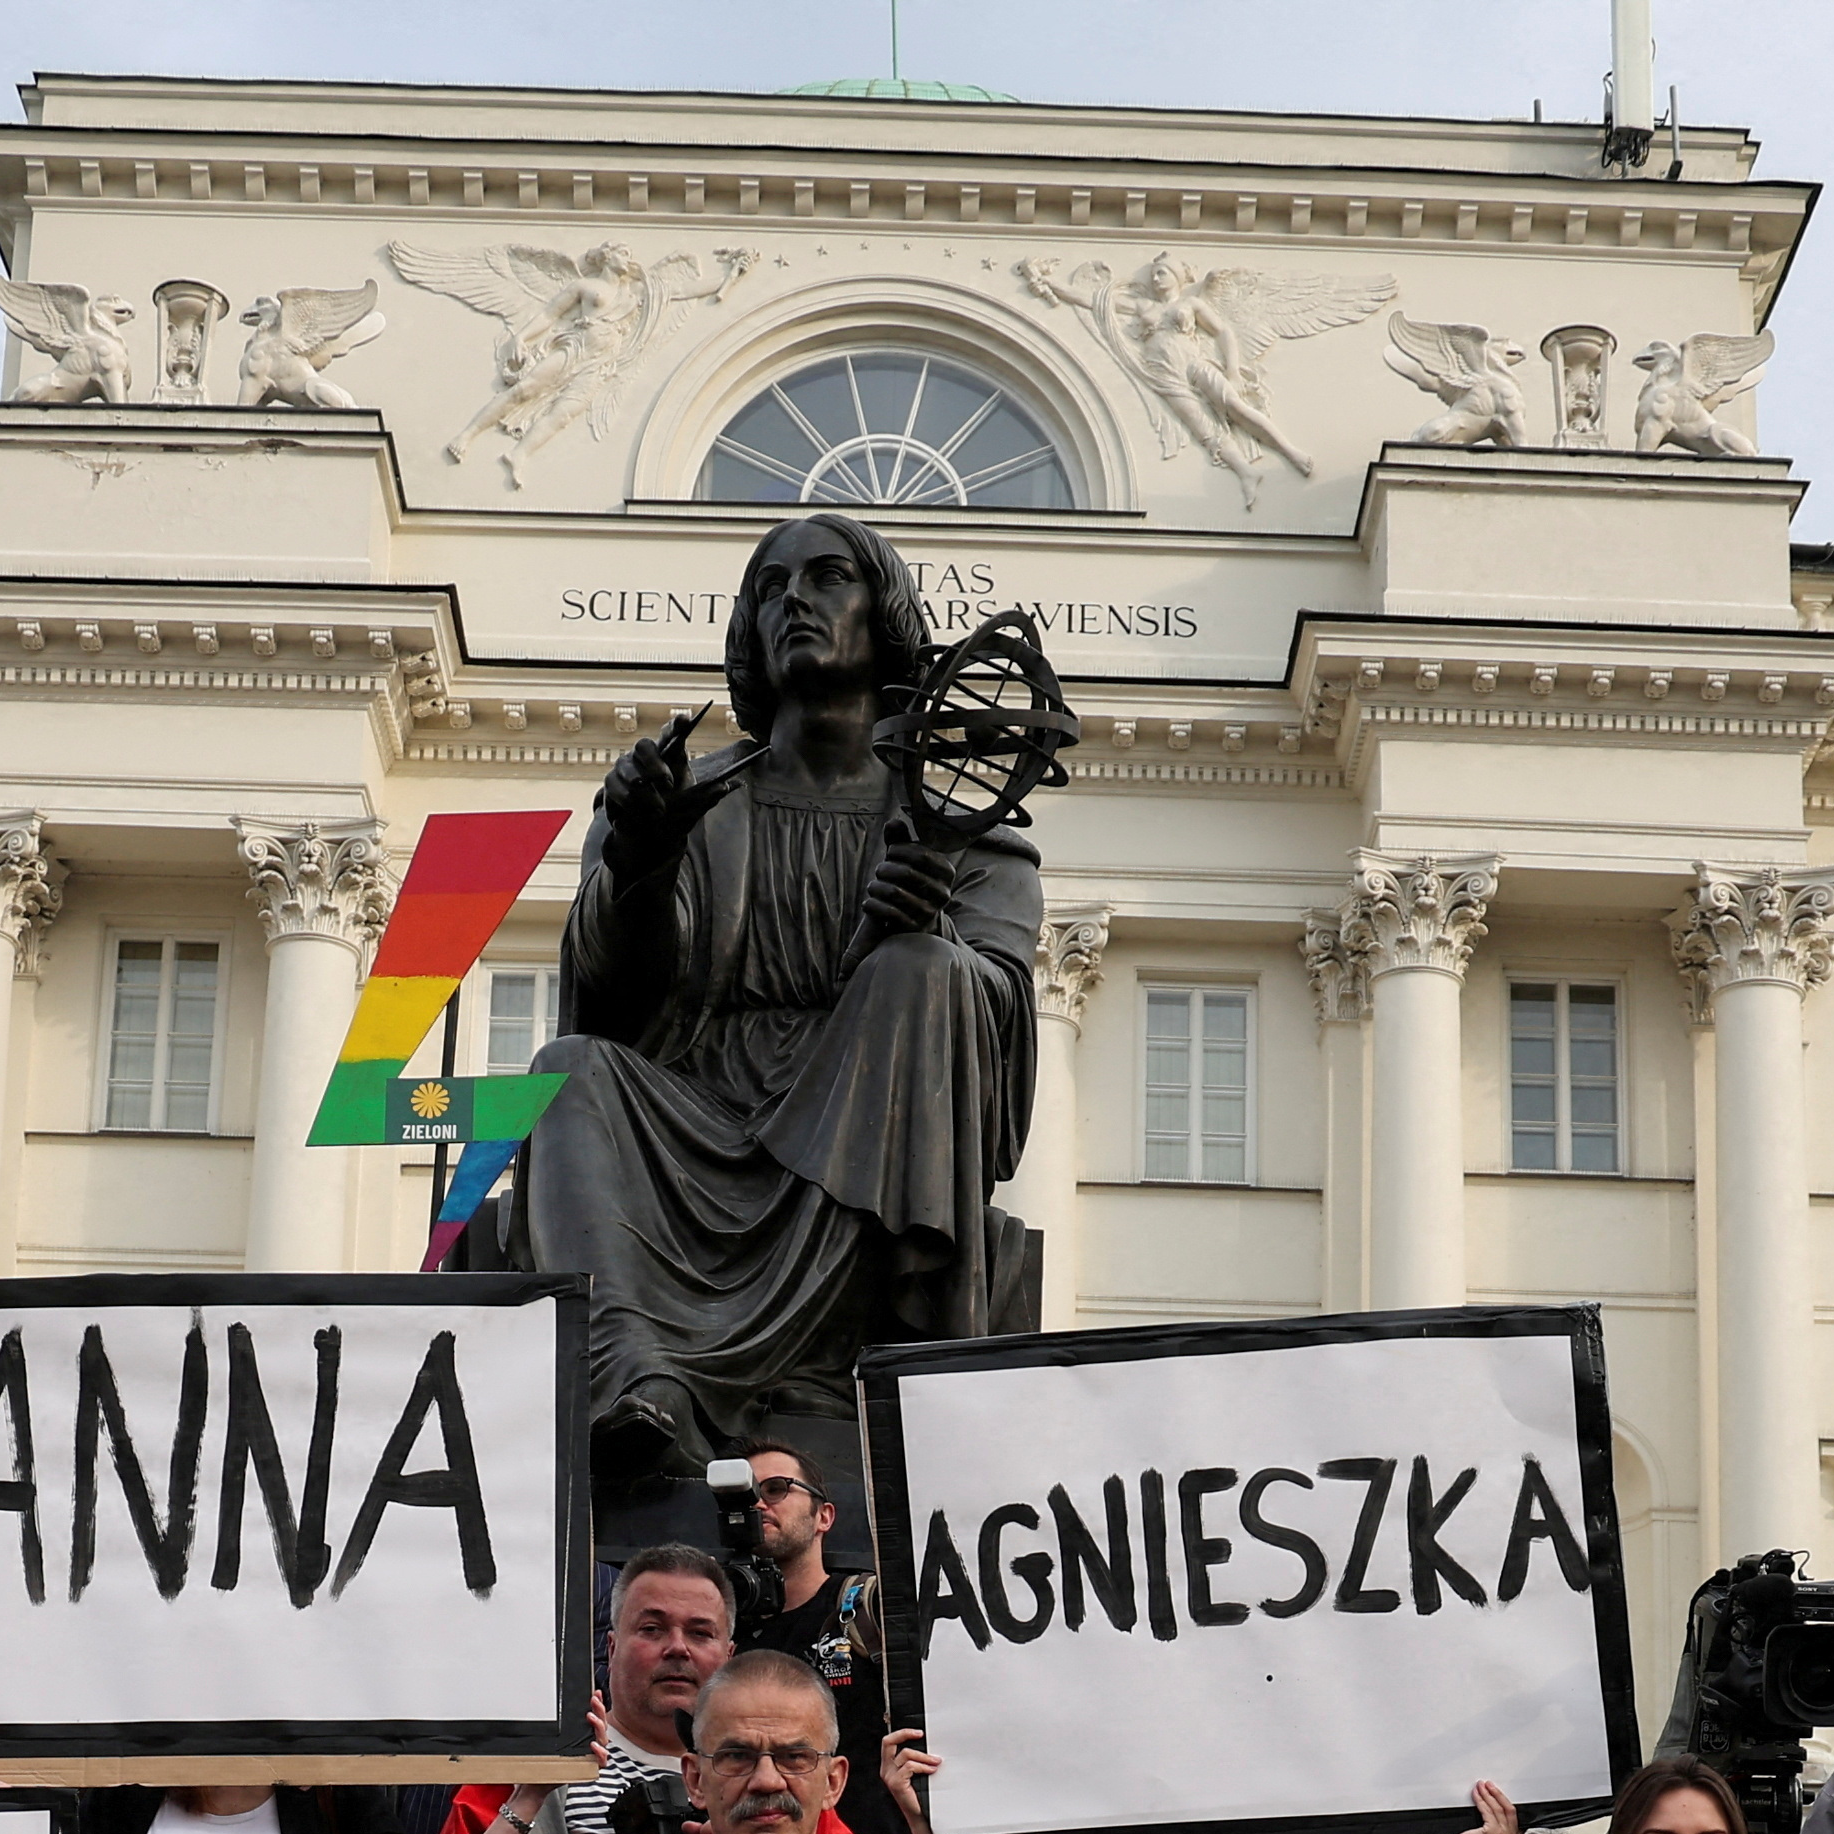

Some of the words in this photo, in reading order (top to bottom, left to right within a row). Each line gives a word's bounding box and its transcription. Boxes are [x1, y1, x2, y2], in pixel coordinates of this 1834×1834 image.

[908, 563, 994, 594] TAS
[402, 1124, 457, 1140] ZIELONI
[920, 1456, 1590, 1653] AGNIESZKA
